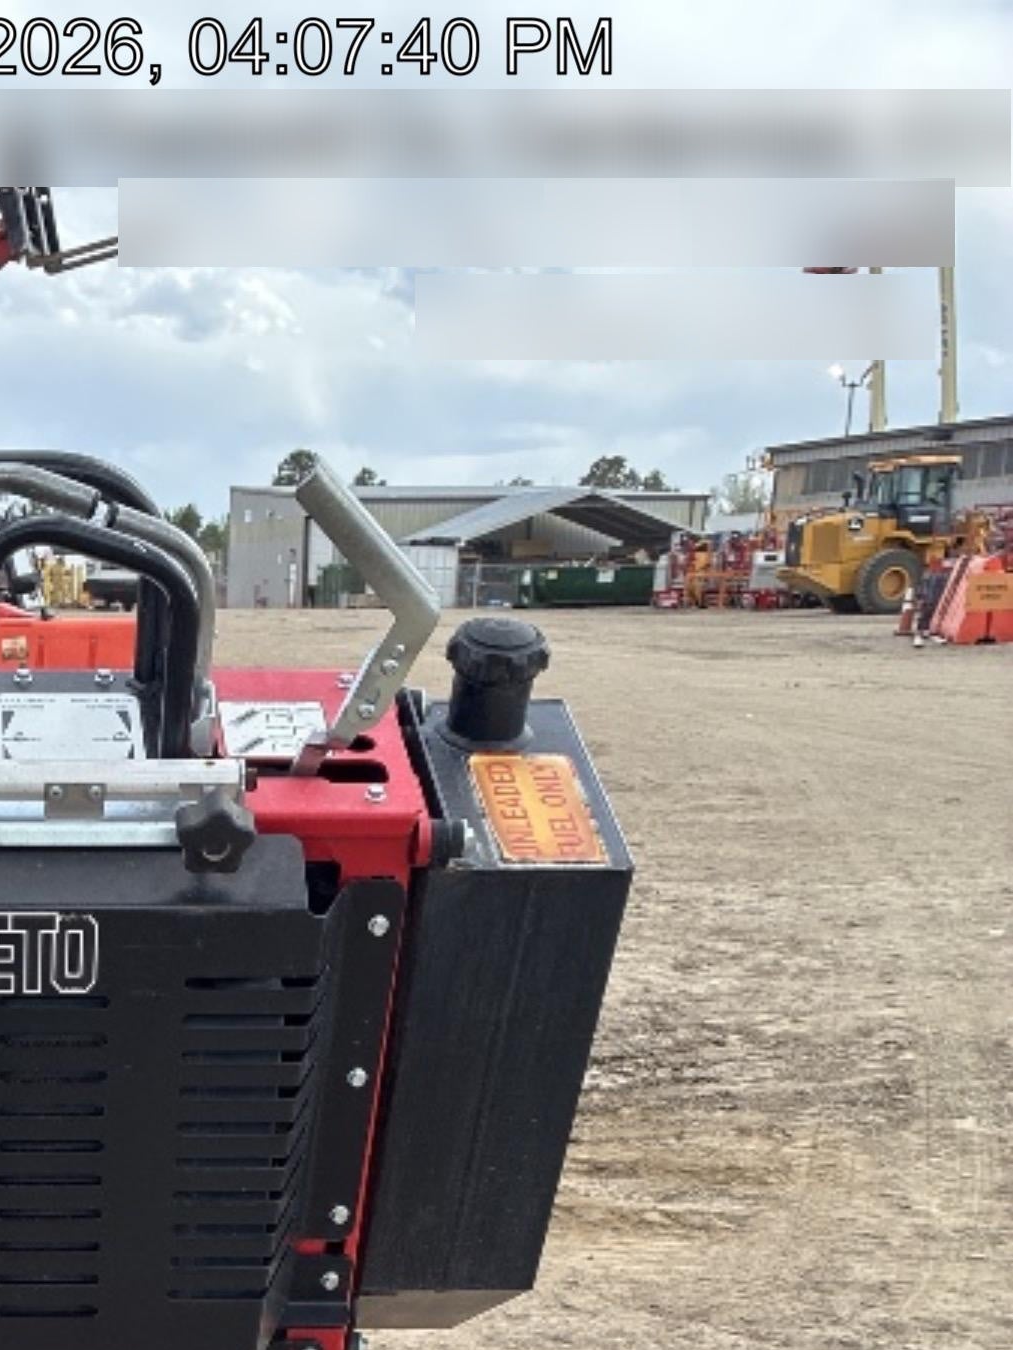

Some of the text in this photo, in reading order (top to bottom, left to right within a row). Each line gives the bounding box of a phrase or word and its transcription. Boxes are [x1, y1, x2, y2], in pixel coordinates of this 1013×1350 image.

[486, 761, 544, 857] UNLEADED
[529, 760, 585, 857] FUEL ONLY
